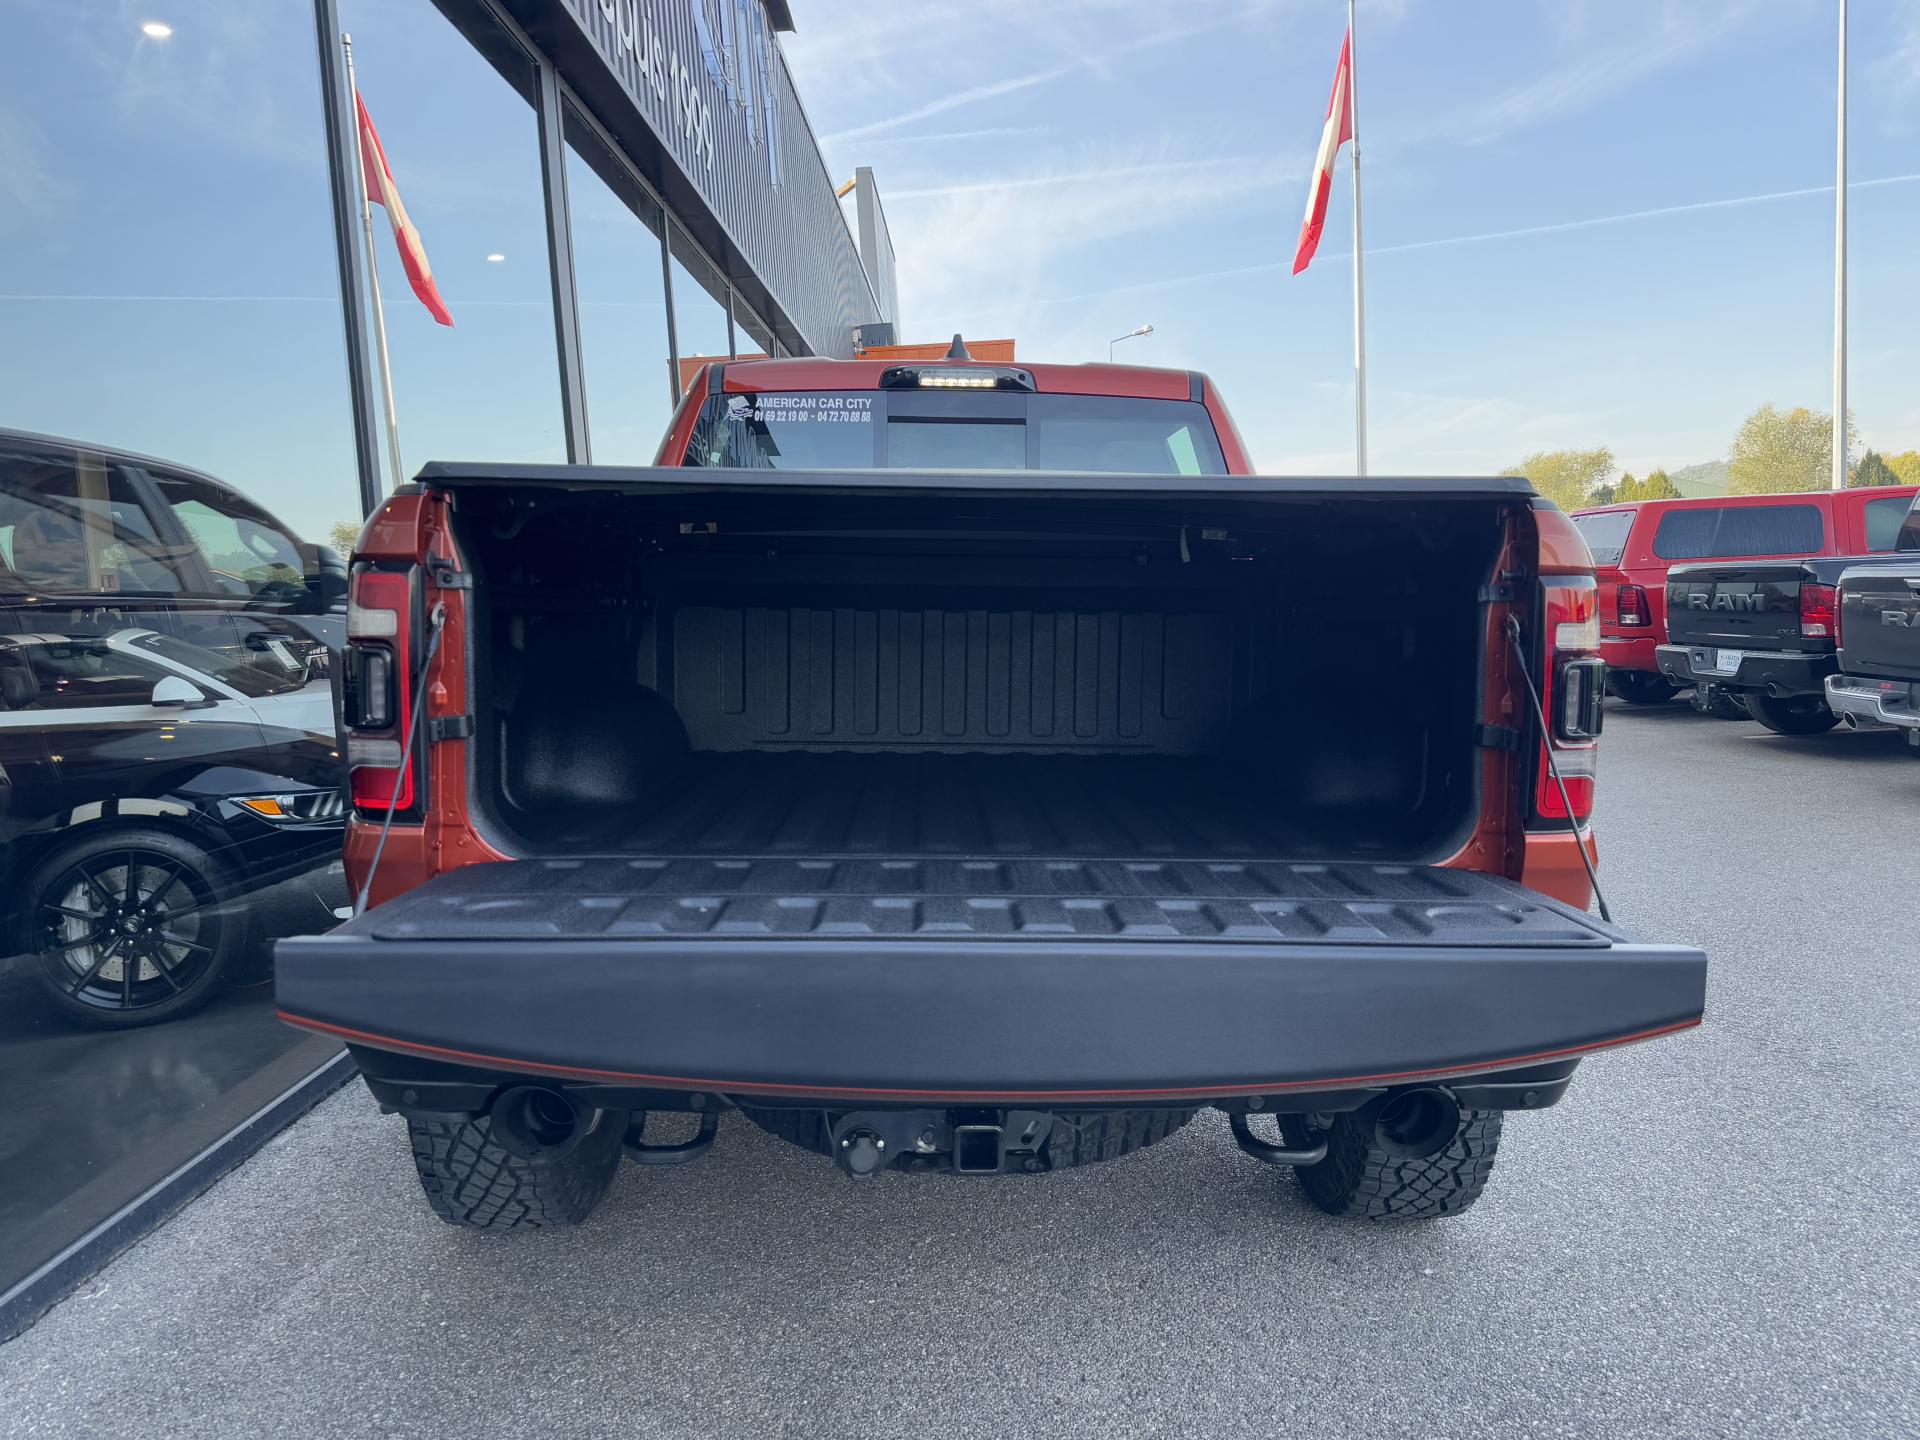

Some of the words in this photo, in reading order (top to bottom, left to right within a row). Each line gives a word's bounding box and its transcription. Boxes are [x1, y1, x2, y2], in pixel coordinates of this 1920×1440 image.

[600, 0, 664, 102] puis
[670, 50, 713, 171] 1999
[755, 398, 816, 408] AMERICAN
[819, 398, 846, 409] CAR
[847, 398, 872, 409] CITY
[754, 411, 764, 422] 01
[764, 411, 776, 422] 69
[776, 411, 786, 422] 22
[788, 411, 797, 422] 19
[798, 411, 808, 422] 00
[817, 411, 828, 422] 04
[829, 411, 839, 422] 72
[839, 411, 849, 422] 70
[850, 411, 860, 422] 88
[1688, 593, 1766, 611] RAM
